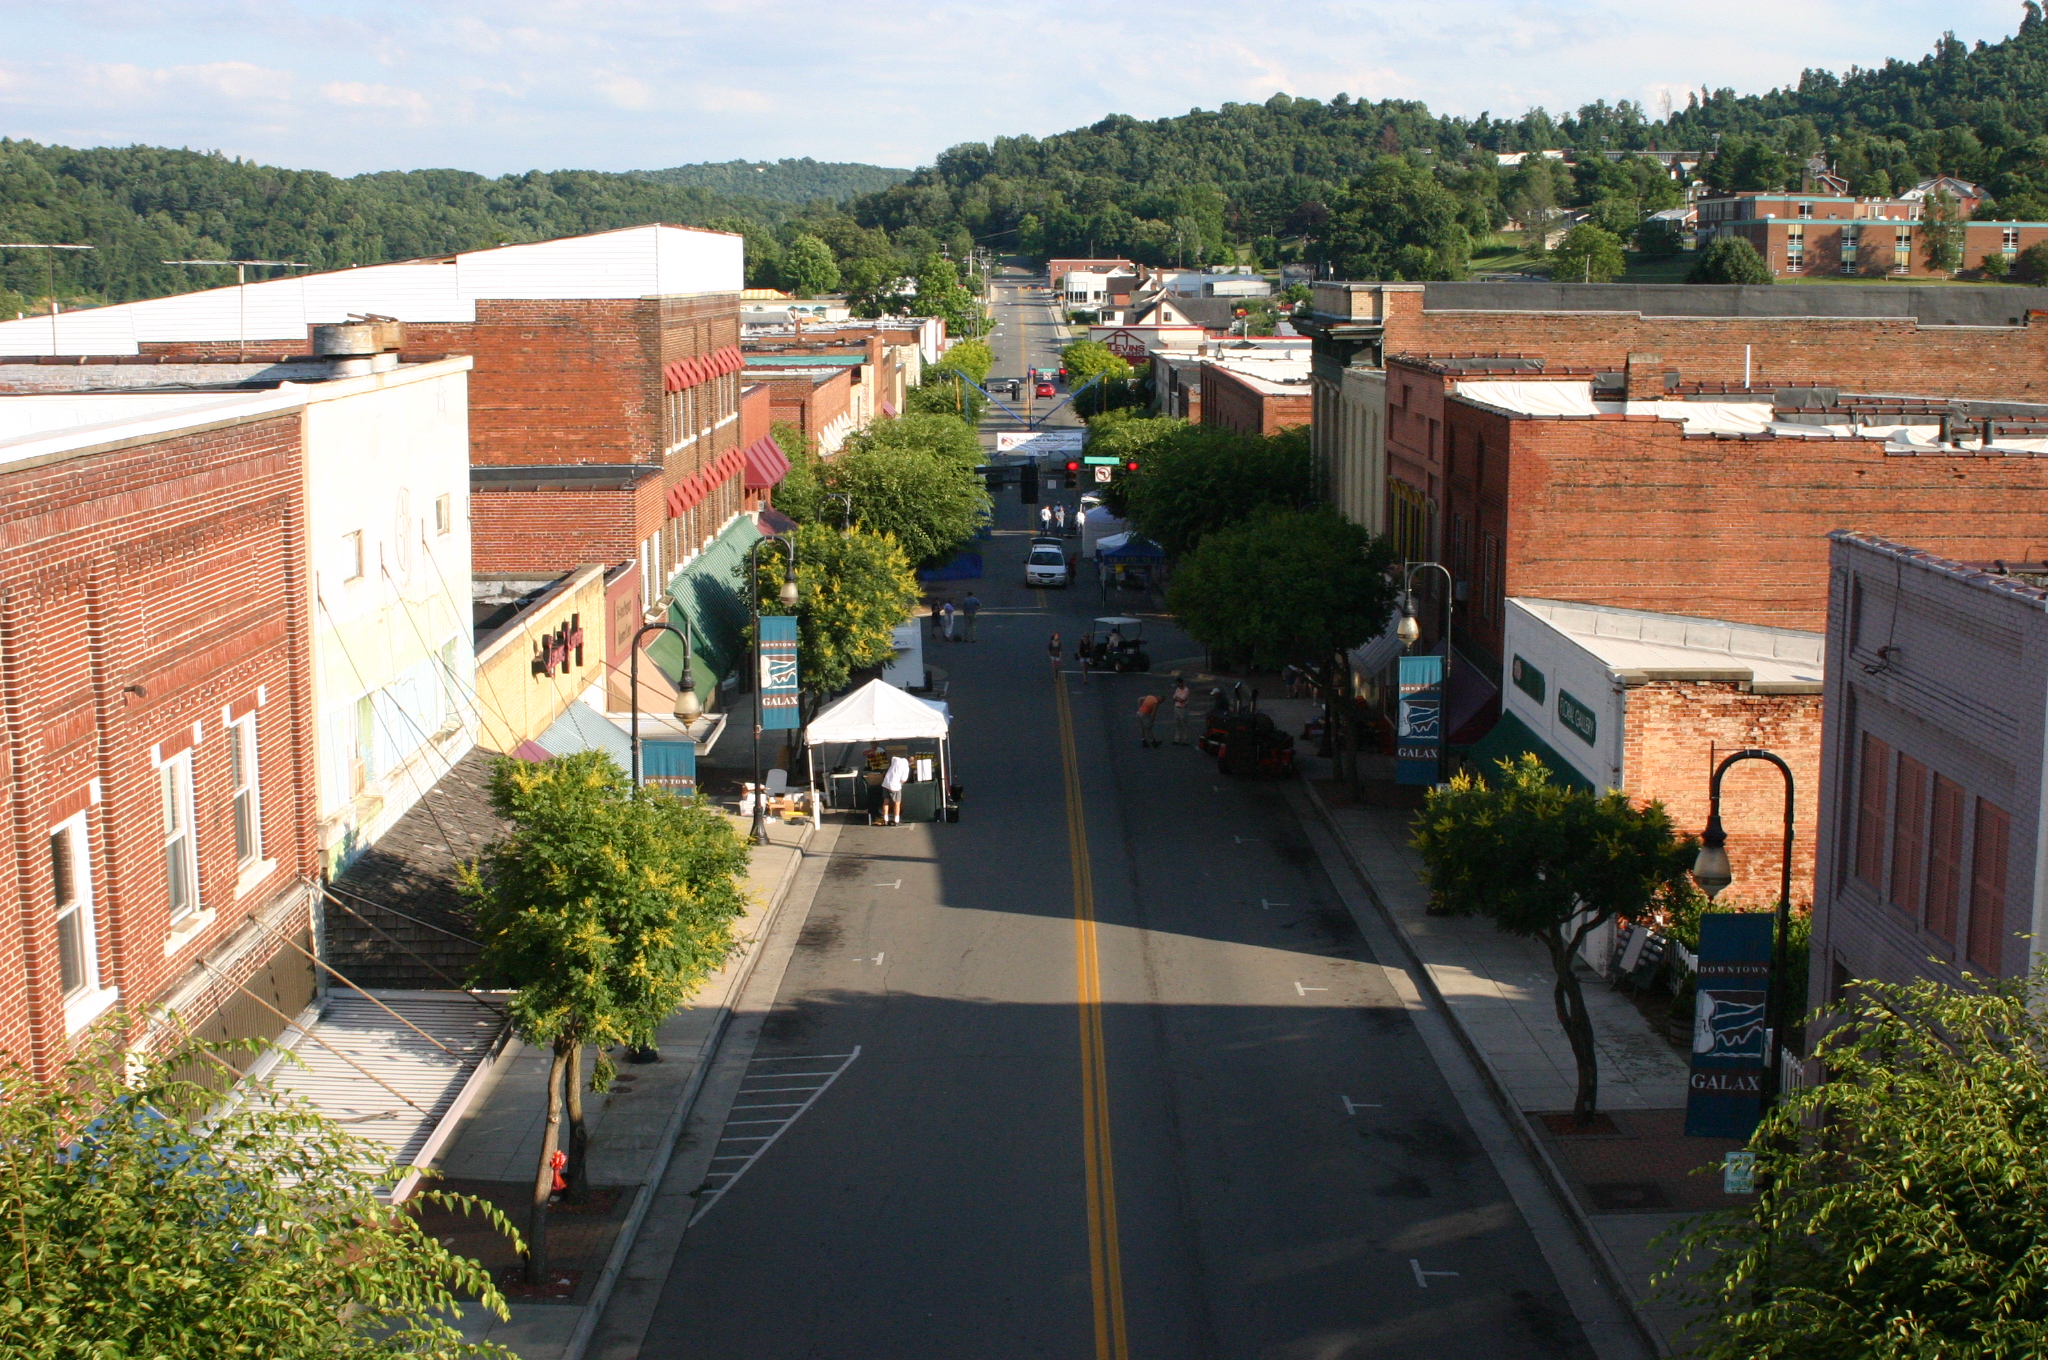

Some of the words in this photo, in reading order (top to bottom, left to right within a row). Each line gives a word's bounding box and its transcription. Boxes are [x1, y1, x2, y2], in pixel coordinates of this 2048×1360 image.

[762, 697, 798, 706] GALAX
[1560, 697, 1575, 724] FLORAL
[1575, 709, 1594, 738] GALLERY
[1398, 747, 1438, 758] GALAX
[1700, 965, 1769, 974] DOWNTOWN
[1691, 1073, 1761, 1091] GALAX
